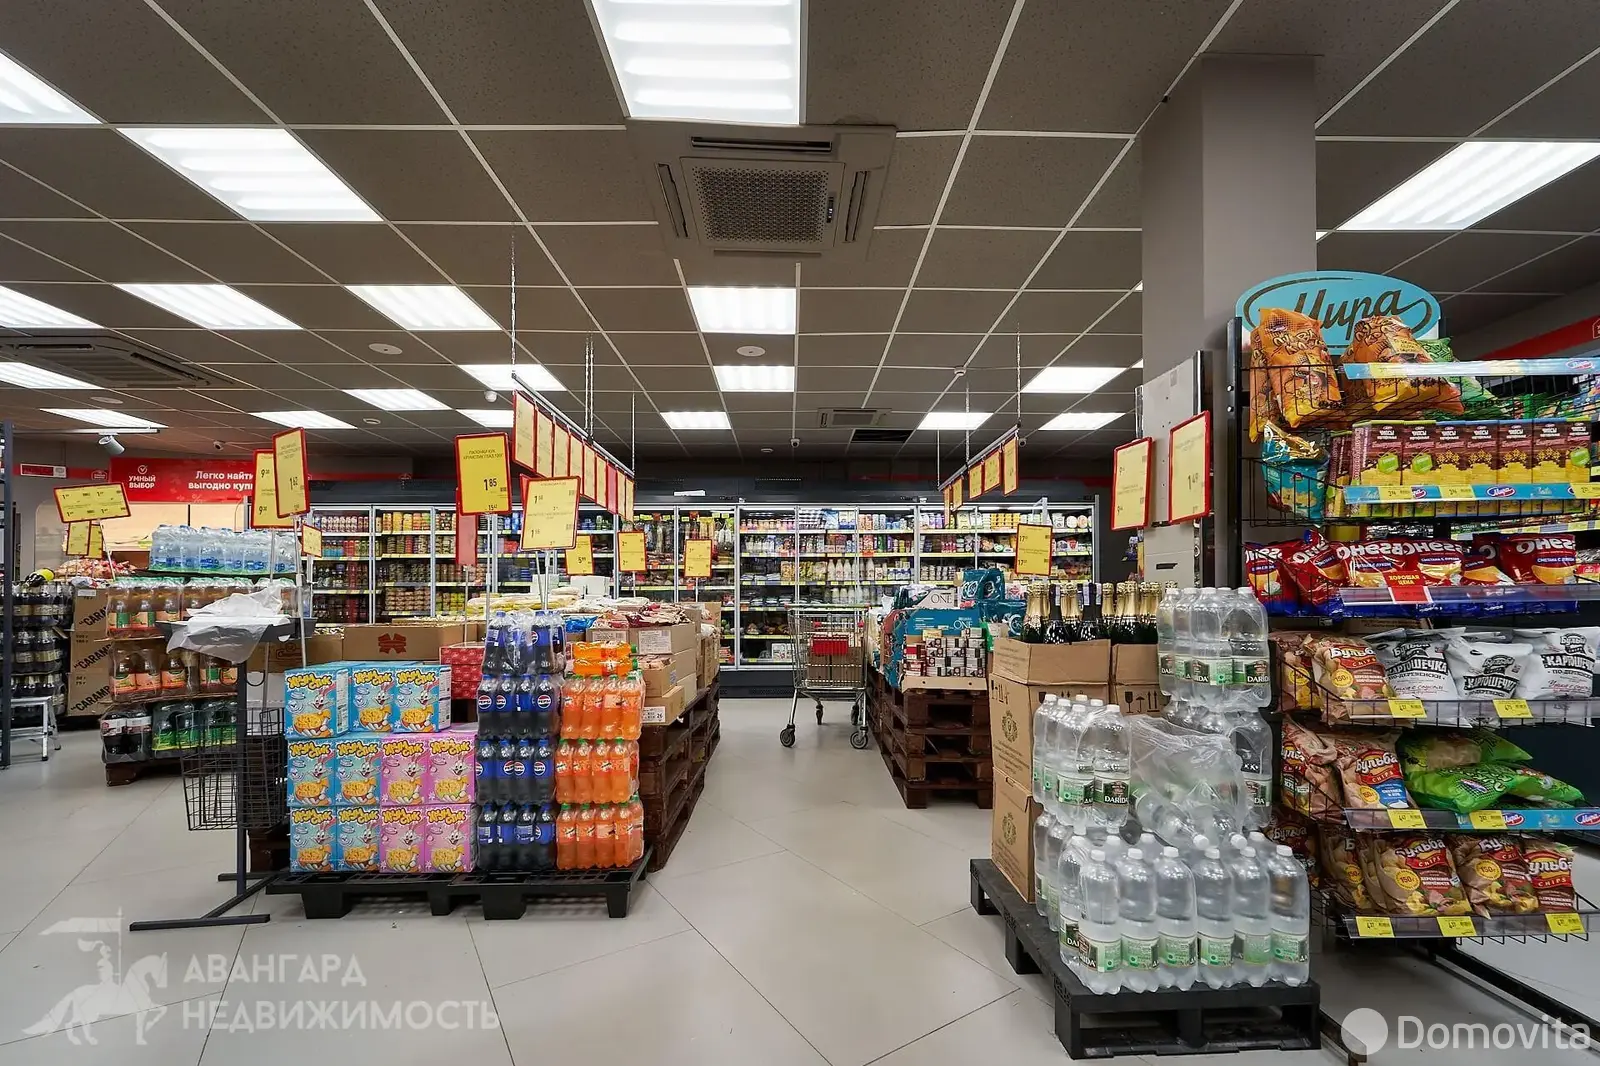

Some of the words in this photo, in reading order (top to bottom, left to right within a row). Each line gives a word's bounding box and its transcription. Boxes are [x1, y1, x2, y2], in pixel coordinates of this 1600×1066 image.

[128, 474, 156, 482] УМНЫЙ
[195, 470, 225, 480] Легко
[188, 482, 231, 492] выгодно
[1516, 537, 1576, 554] Онег
[1330, 647, 1377, 659] Бульб
[1247, 675, 1270, 683] DARID
[1355, 752, 1399, 773] Бульба
[1418, 857, 1442, 867] CHIPS
[1537, 877, 1568, 887] CHIPS
